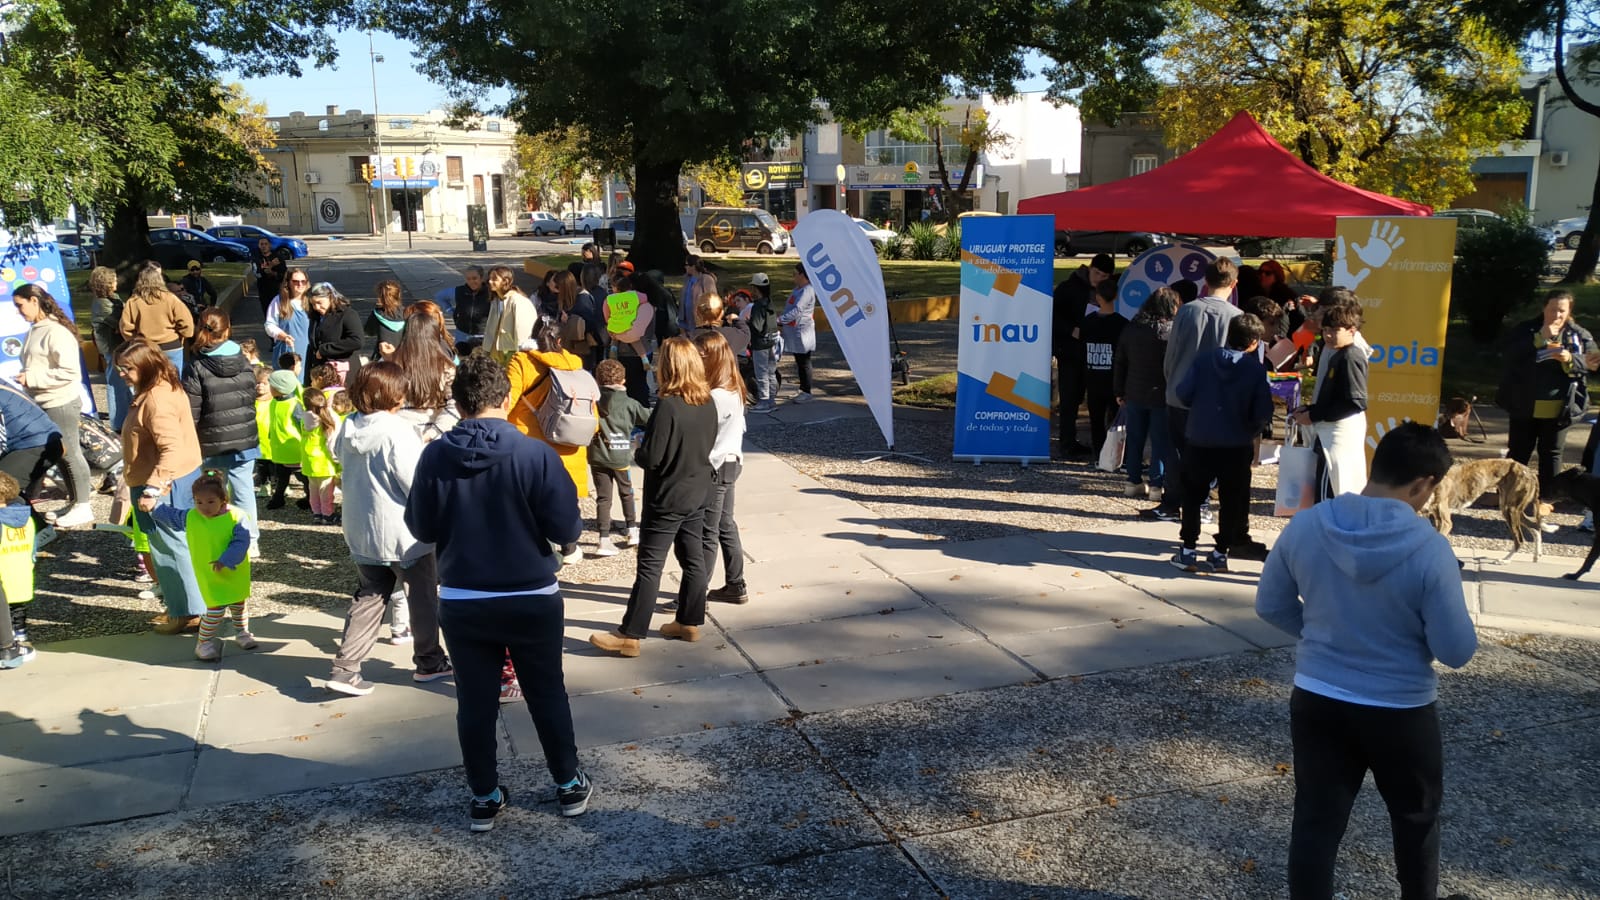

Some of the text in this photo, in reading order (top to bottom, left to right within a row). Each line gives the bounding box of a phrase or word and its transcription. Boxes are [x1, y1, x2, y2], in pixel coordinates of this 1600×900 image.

[969, 243, 1046, 254] URUGUAY PROTEGE
[991, 256, 1018, 266] niños,
[1020, 256, 1046, 265] niñas
[982, 265, 1038, 275] adolescentes
[971, 315, 1039, 343] inau
[1086, 343, 1113, 353] TRAVEL
[1086, 352, 1113, 365] ROCK
[974, 411, 1031, 421] COMPROMISO
[966, 422, 1038, 433] de todos y todas
